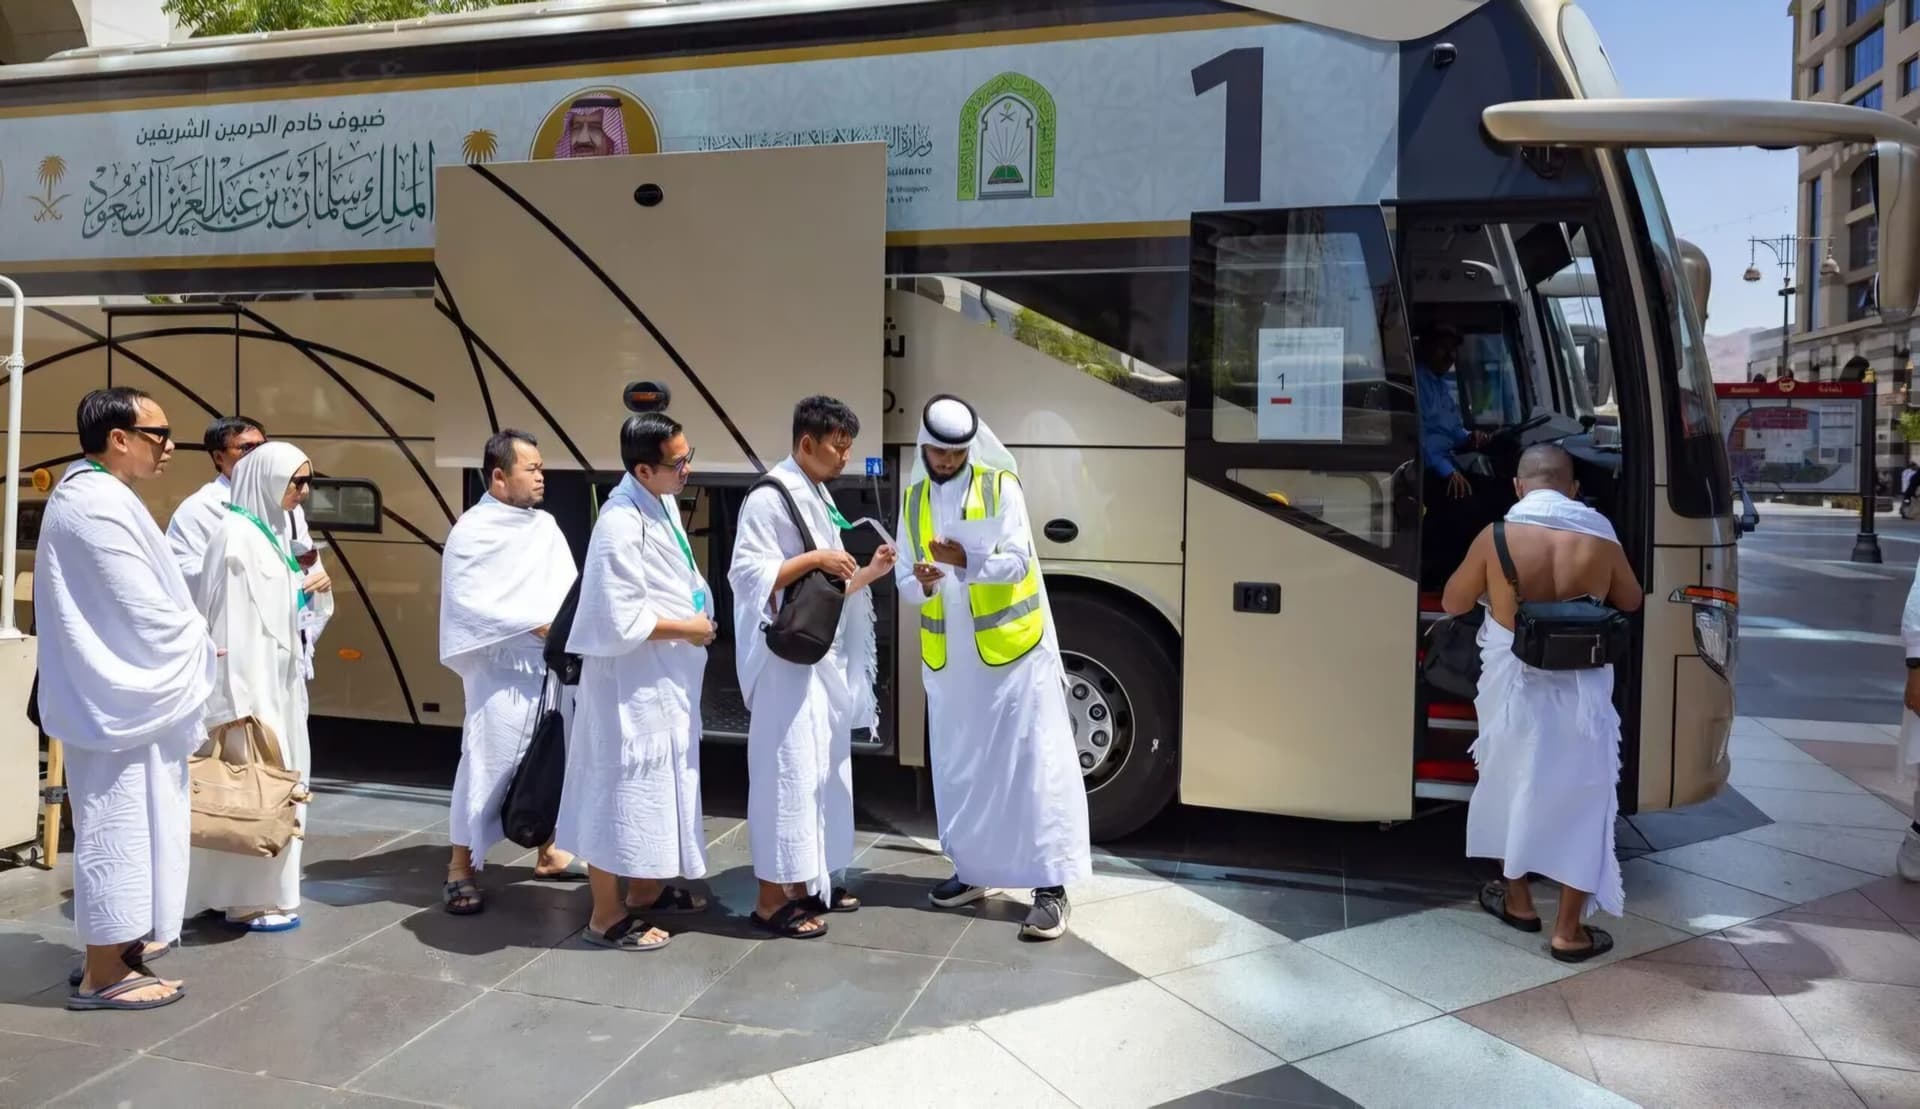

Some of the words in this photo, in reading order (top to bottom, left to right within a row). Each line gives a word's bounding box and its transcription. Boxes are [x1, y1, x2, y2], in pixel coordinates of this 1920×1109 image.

[136, 118, 210, 146] الشريفين
[214, 115, 277, 141] الحرمين
[282, 112, 323, 139] خادم
[328, 109, 386, 131] ضيوف
[1191, 47, 1264, 203] 1
[272, 146, 362, 230] سلمان
[343, 140, 435, 233] الملك
[82, 170, 145, 238] سعود
[1277, 372, 1286, 391] 1
